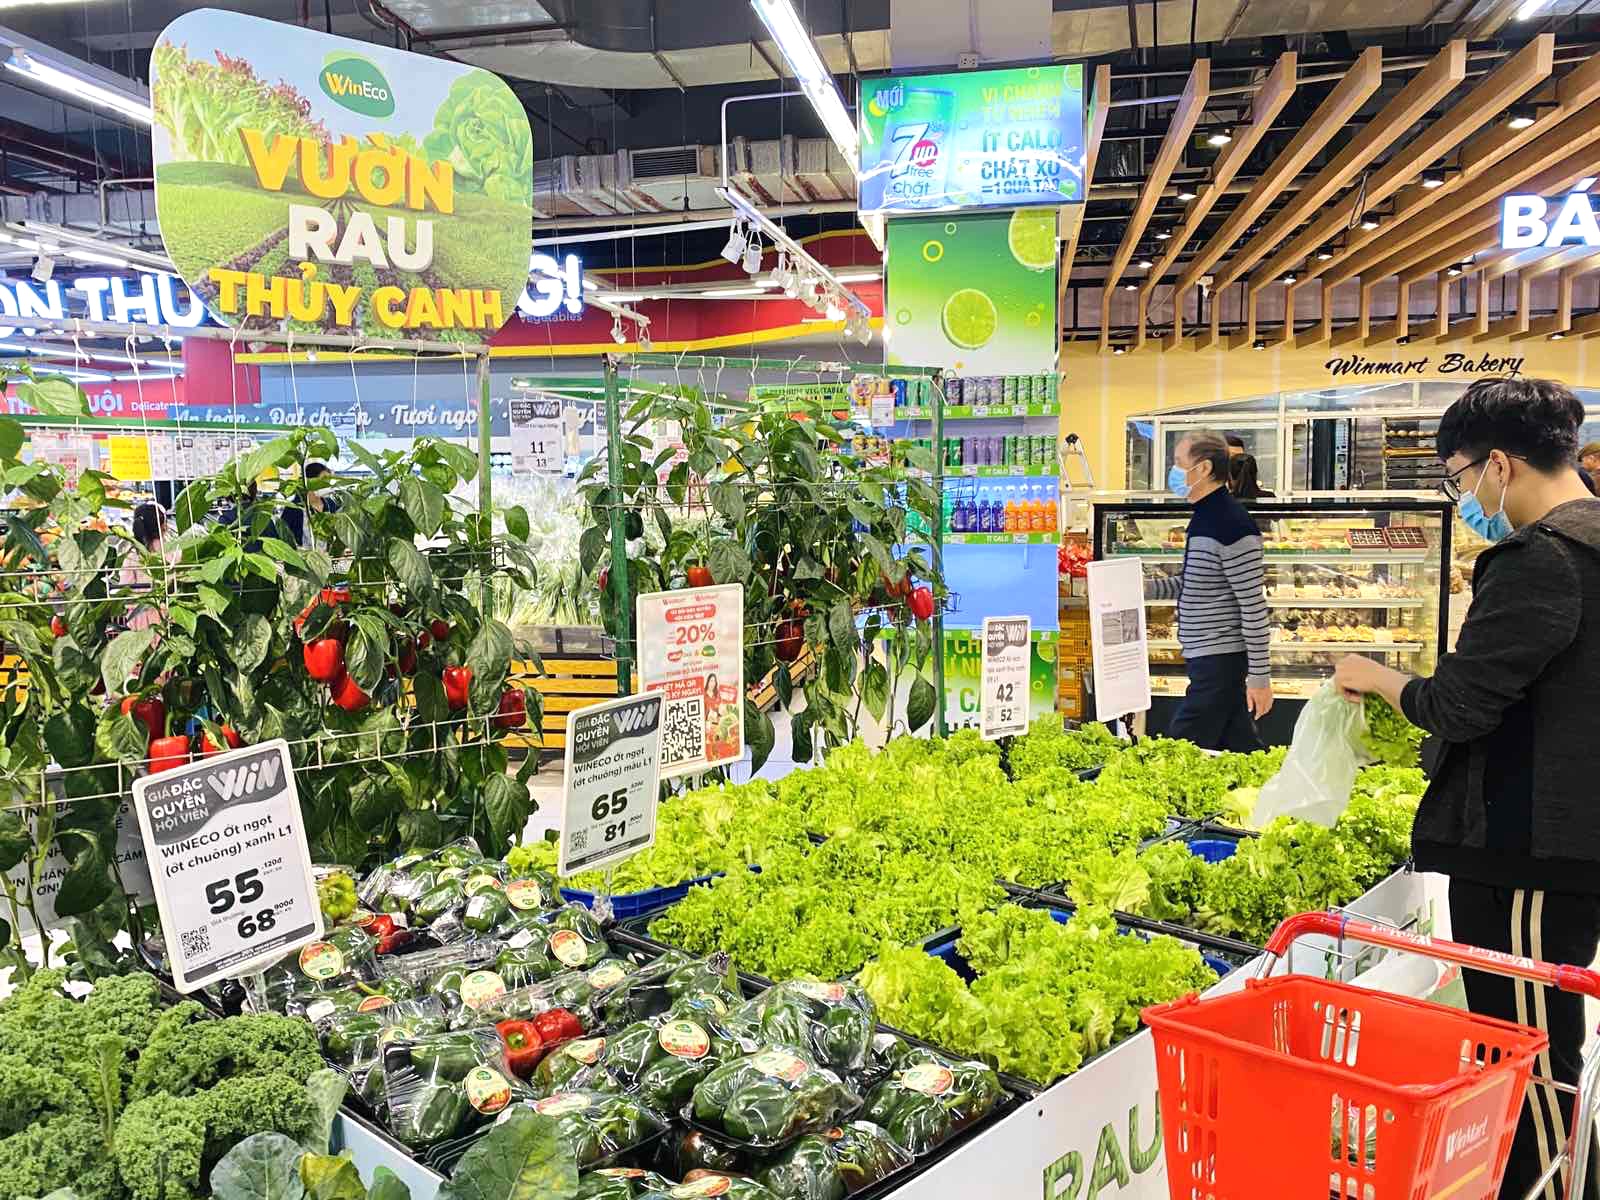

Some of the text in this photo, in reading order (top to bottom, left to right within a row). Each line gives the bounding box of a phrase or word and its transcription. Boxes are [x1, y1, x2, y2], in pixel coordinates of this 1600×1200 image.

[325, 72, 389, 104] WinEco
[240, 127, 456, 214] VƯỜN
[288, 204, 435, 273] RAU
[208, 261, 504, 329] THỦY CANH
[1325, 352, 1526, 379] Winmart Bakery
[390, 403, 437, 427] Tươi
[530, 442, 545, 454] 11
[996, 683, 1014, 702] 42
[1001, 709, 1012, 722] 52
[574, 756, 611, 774] WINECO
[170, 777, 203, 797] ĐẶC
[151, 791, 206, 820] QUYỀN
[592, 787, 629, 821] 65
[155, 807, 209, 833] HỘI VIÊN
[604, 820, 626, 842] 81
[161, 831, 220, 859] WINECO
[245, 829, 276, 850] xanh
[278, 824, 293, 839] L1
[205, 868, 264, 915] 55
[237, 908, 276, 938] 68
